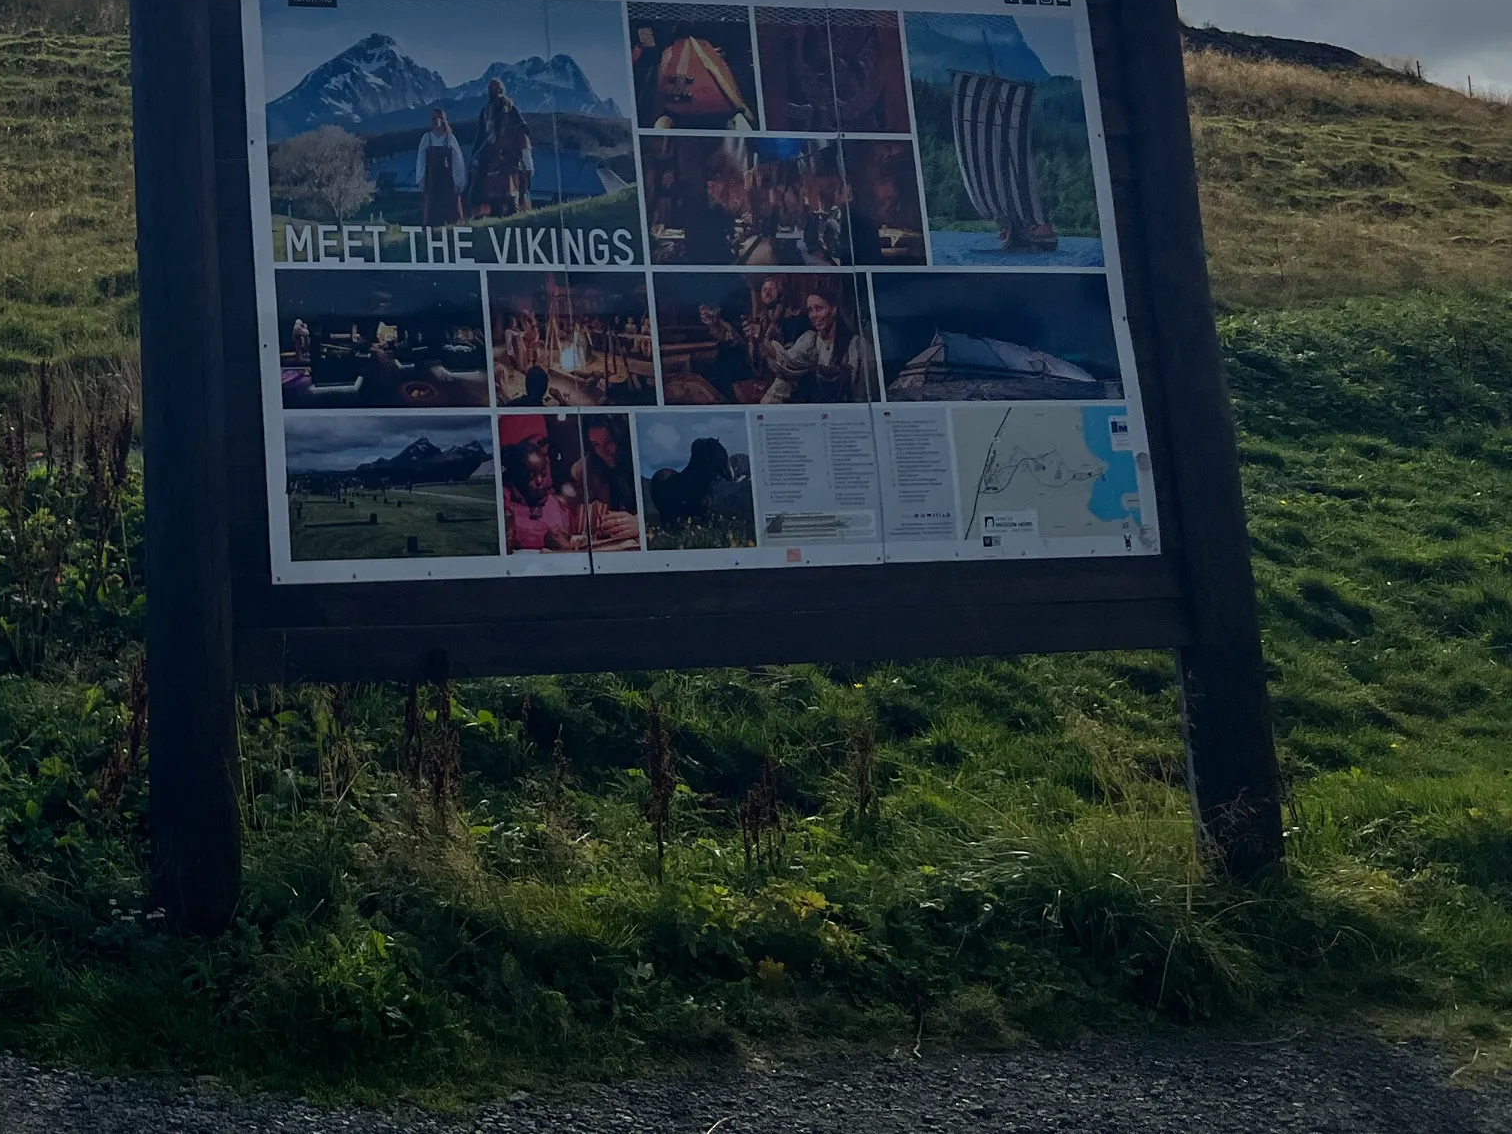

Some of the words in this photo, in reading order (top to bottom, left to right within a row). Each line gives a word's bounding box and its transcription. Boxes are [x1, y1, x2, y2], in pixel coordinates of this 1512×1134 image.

[286, 224, 386, 263] MEET
[401, 226, 475, 264] THE
[488, 227, 635, 266] VIKINGS
